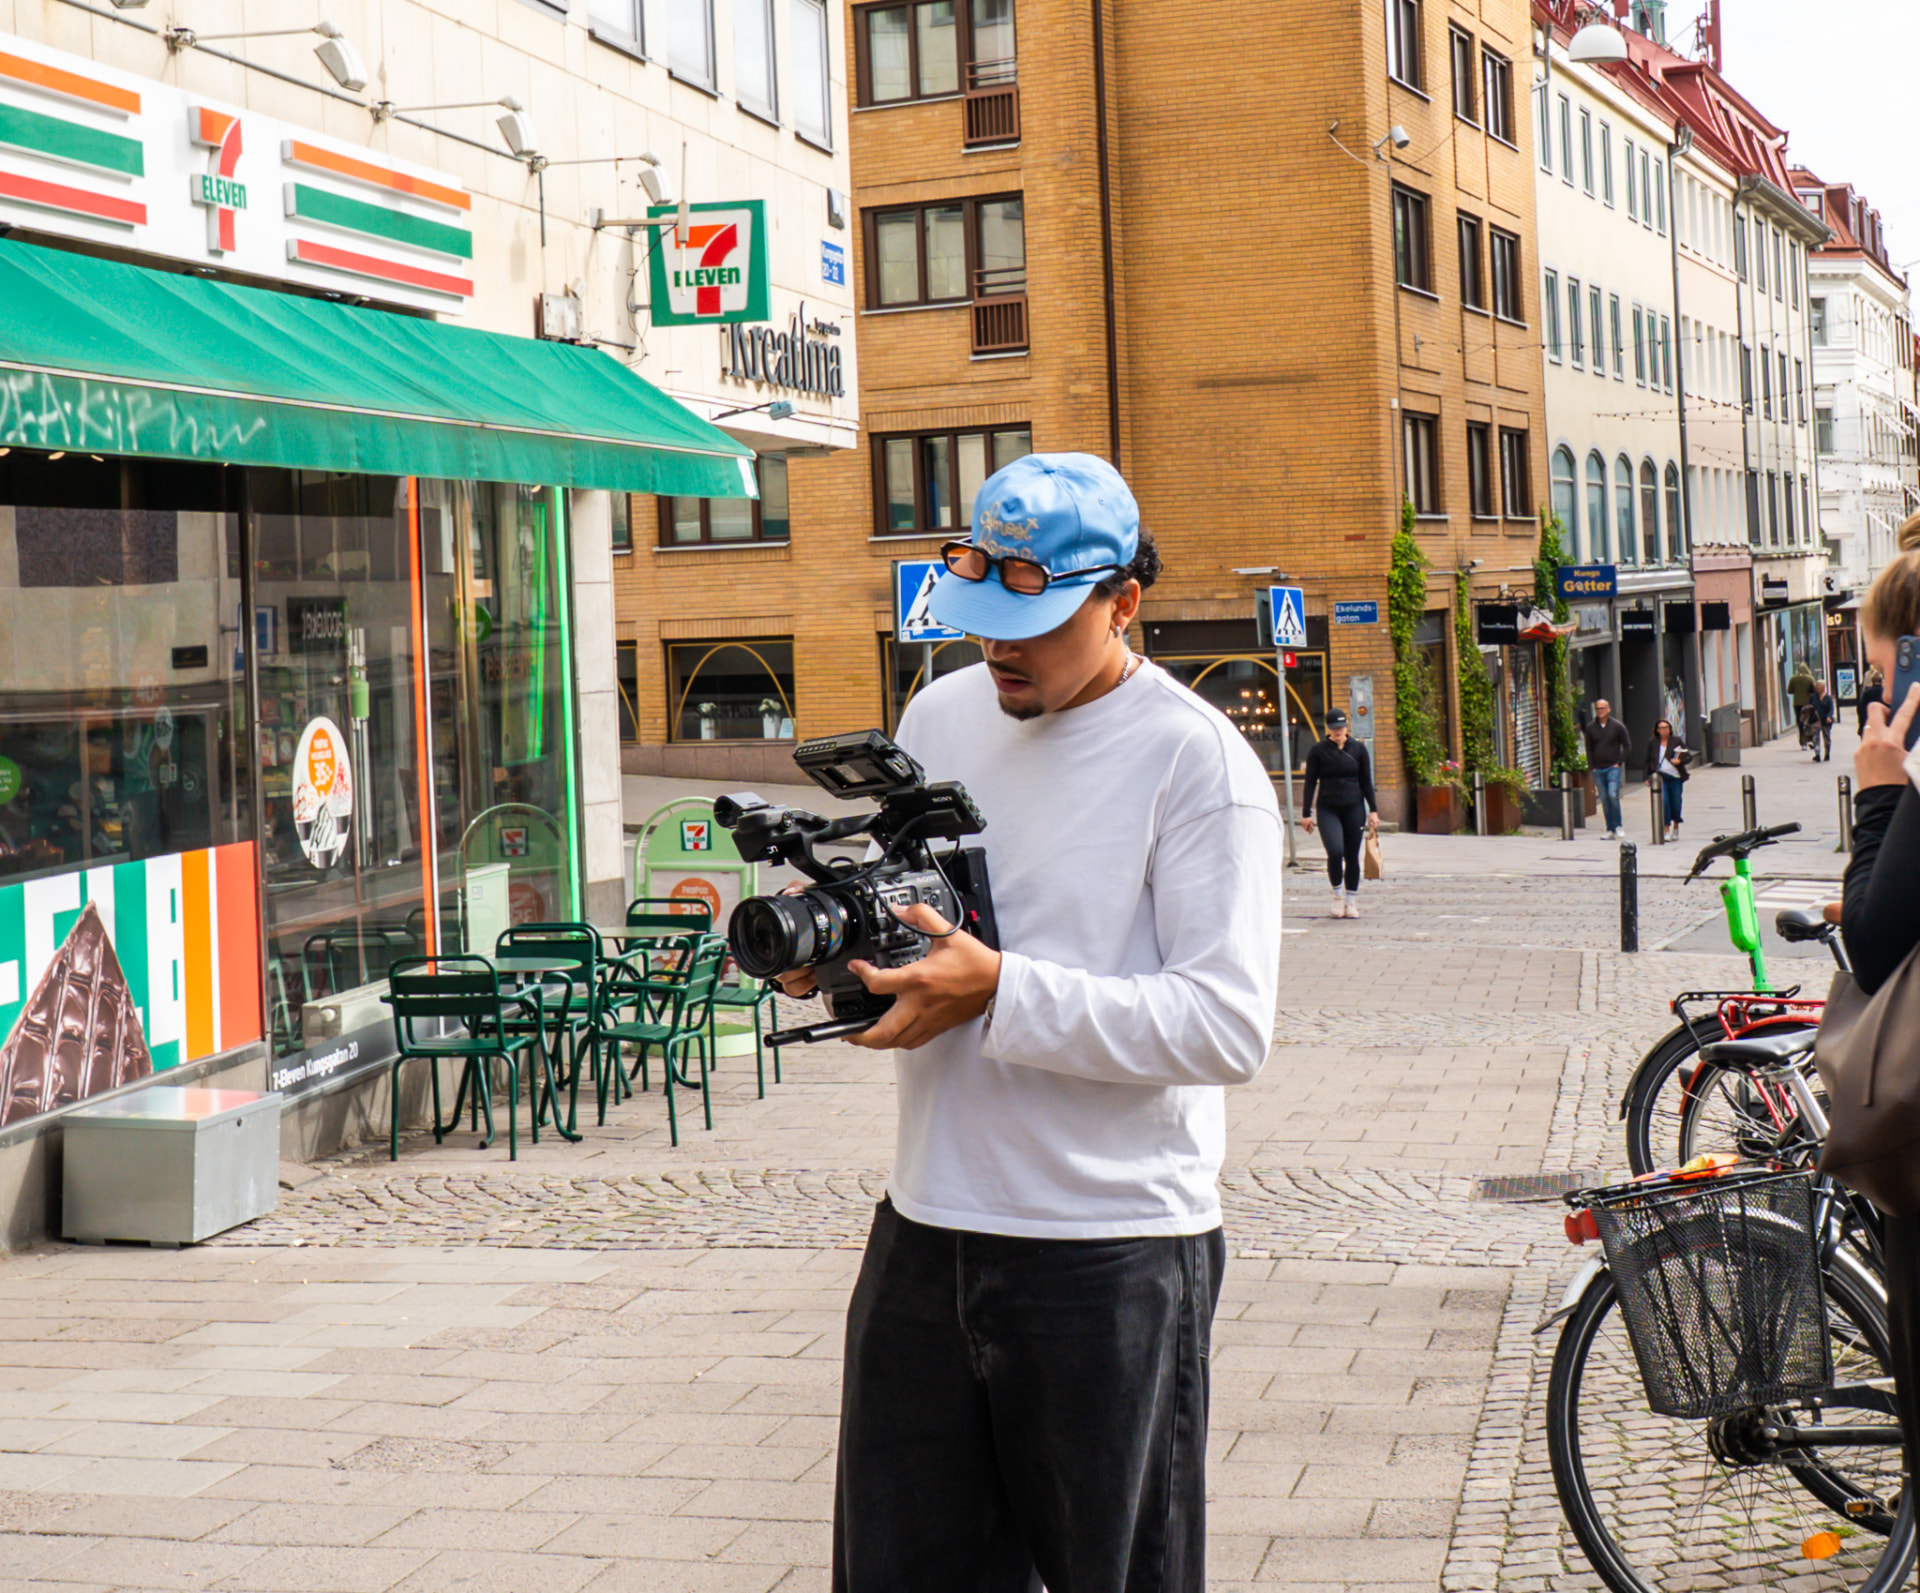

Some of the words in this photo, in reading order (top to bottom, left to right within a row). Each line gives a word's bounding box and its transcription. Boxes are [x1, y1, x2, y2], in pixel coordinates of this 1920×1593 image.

[200, 107, 243, 252] 7
[674, 223, 738, 314] 7
[272, 1065, 306, 1090] 7-Eleven
[306, 1048, 349, 1077] Kungsgatan
[348, 1041, 359, 1060] 20
